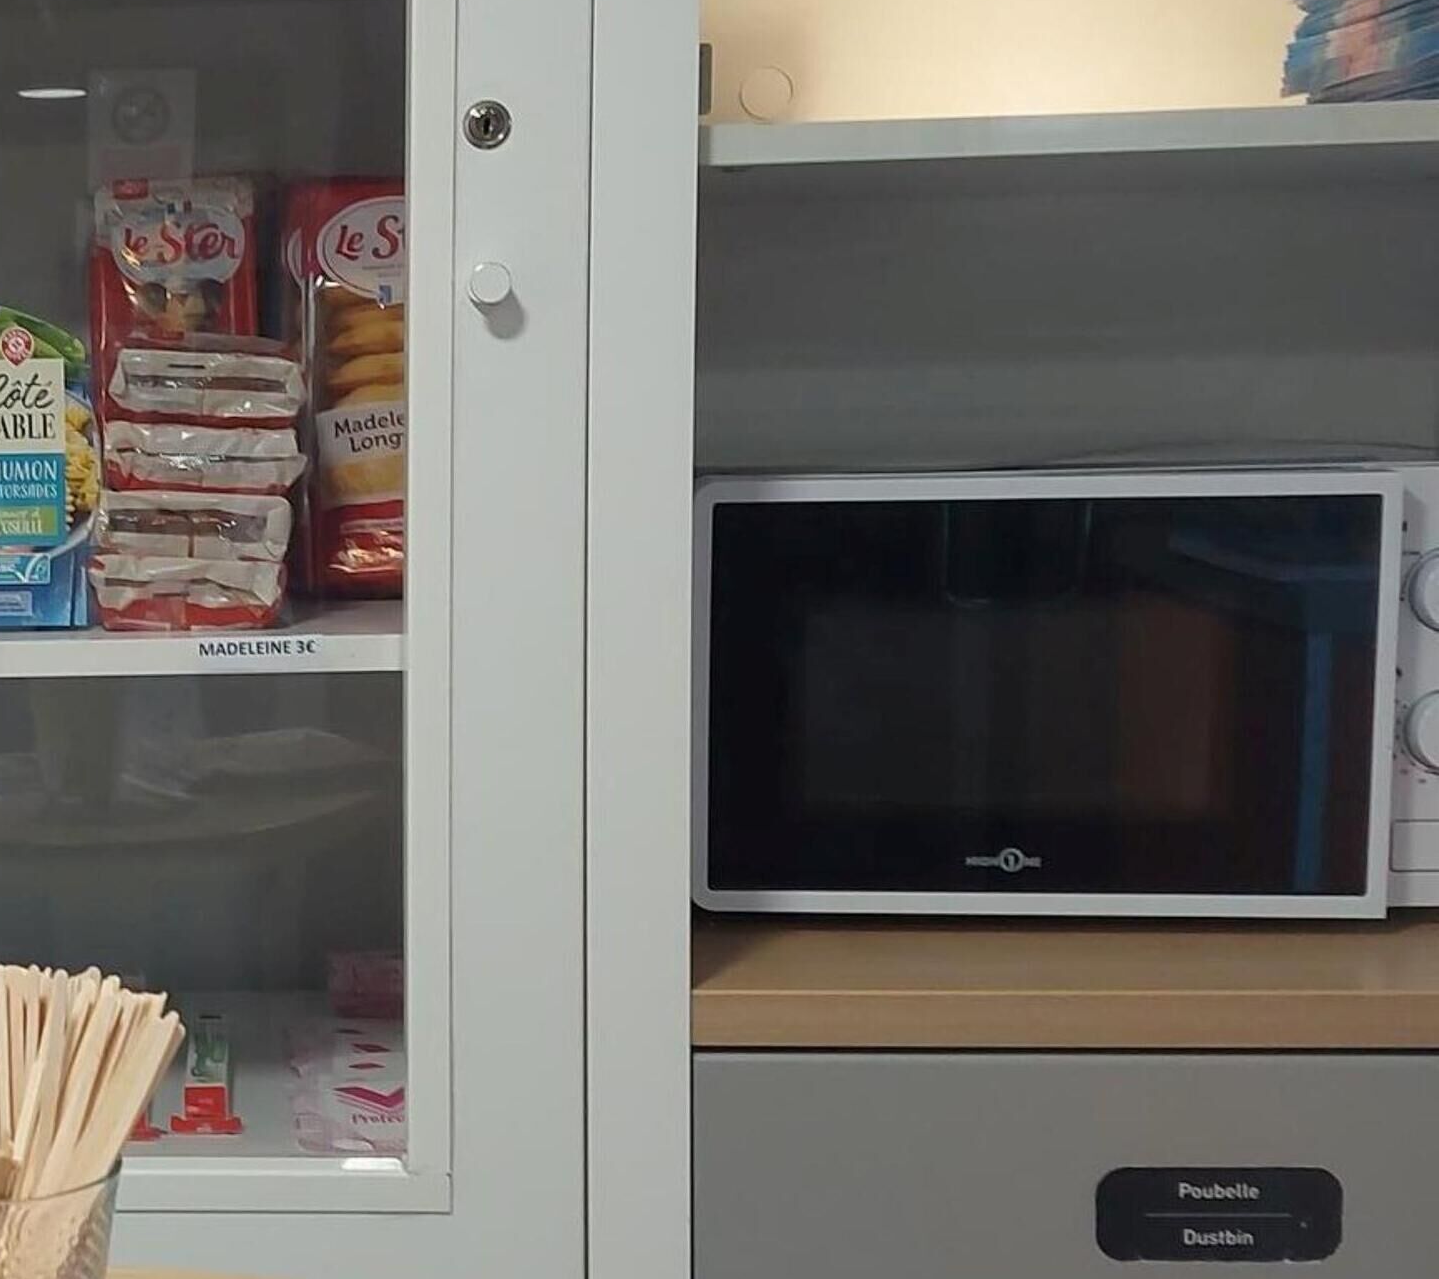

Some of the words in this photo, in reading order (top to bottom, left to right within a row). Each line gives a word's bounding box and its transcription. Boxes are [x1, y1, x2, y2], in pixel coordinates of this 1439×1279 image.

[335, 225, 364, 260] Le
[199, 640, 292, 658] MADELEINE
[296, 639, 316, 655] 3€
[1178, 1182, 1260, 1199] Poubelle
[1183, 1228, 1254, 1245] Dustbin
